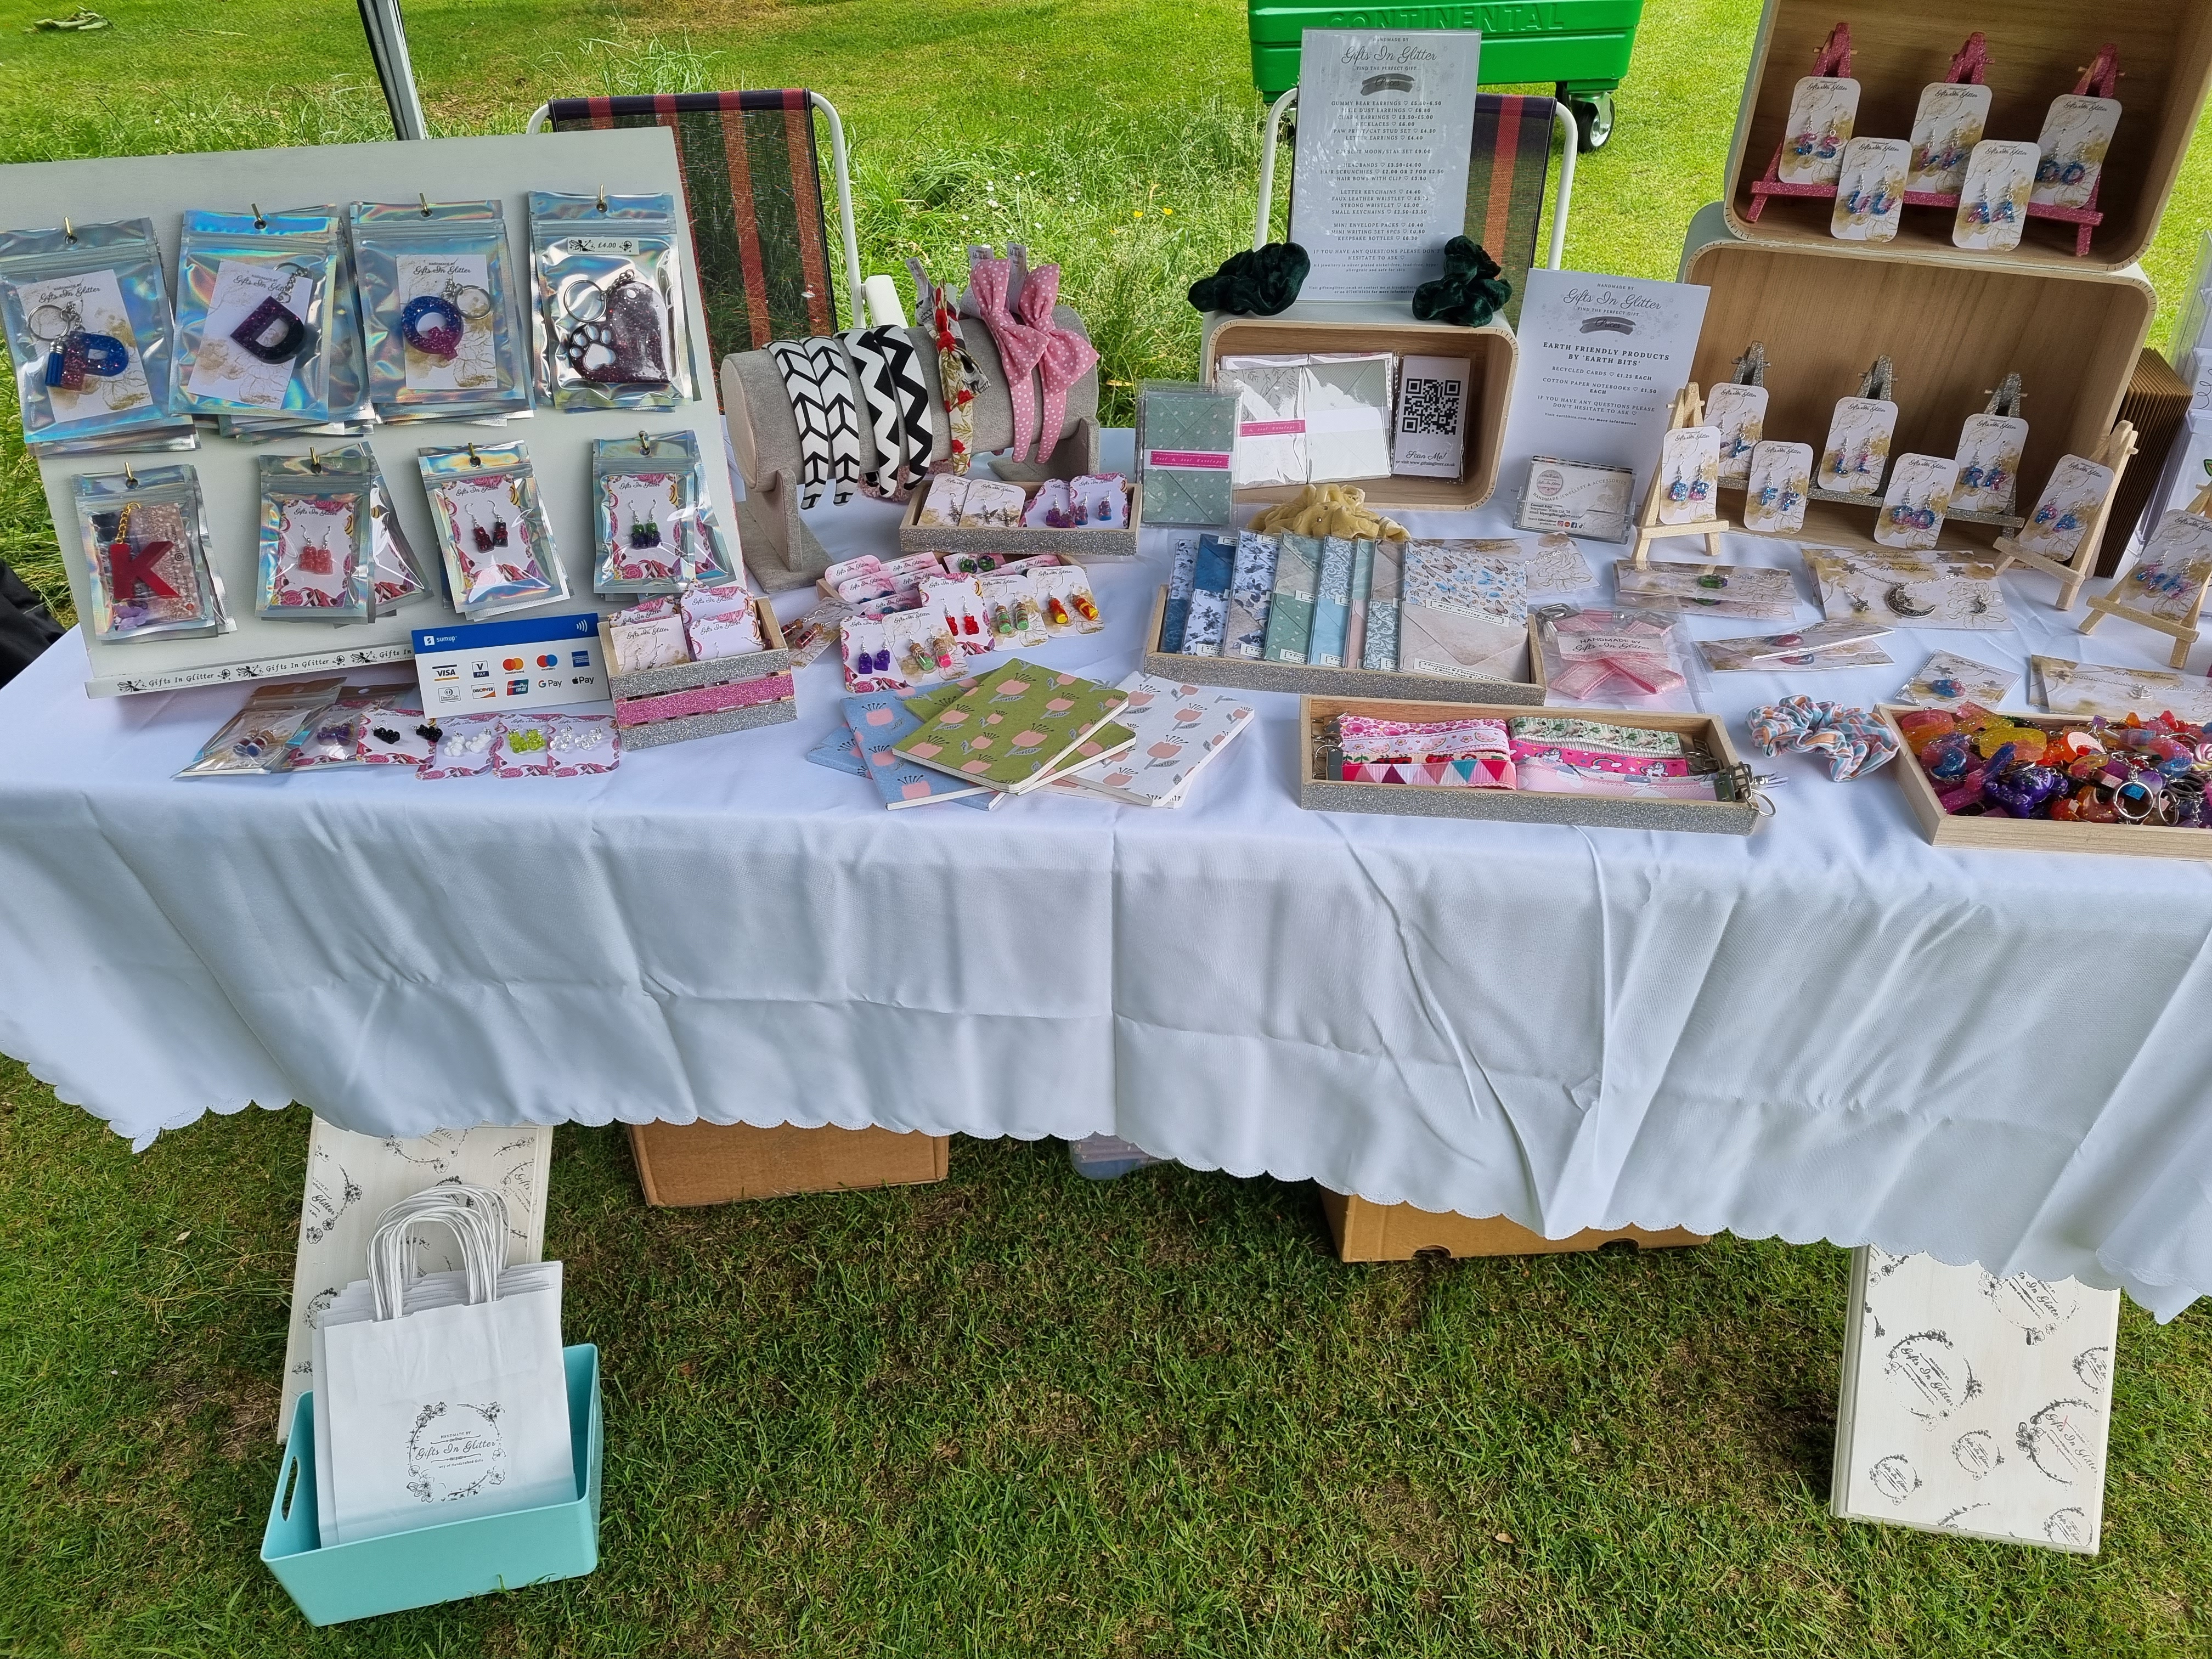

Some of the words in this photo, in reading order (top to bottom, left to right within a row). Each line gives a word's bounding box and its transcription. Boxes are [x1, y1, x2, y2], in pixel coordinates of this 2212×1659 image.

[1325, 3, 1564, 32] CONTINENTAL
[1341, 47, 1371, 64] Gifts
[1374, 46, 1396, 60] In
[1397, 46, 1437, 63] Glitter
[1375, 77, 1401, 87] Prices
[413, 266, 431, 275] Gifts
[448, 266, 471, 274] Glitter
[39, 293, 58, 303] Gifts
[76, 286, 100, 297] Glitter
[1564, 289, 1594, 304] Gifts
[1596, 291, 1618, 305] In
[1620, 294, 1661, 310] Glitter
[230, 295, 304, 365] D
[402, 296, 464, 361] Q
[1595, 319, 1621, 329] Prices
[1543, 342, 1572, 351] EARTH
[1575, 345, 1619, 356] FRIENDLY
[1622, 351, 1669, 360] PRODUCTS
[61, 331, 129, 391] P
[1592, 383, 1630, 391] NOTEBOOKS
[1594, 401, 1630, 409] QUESTIONS
[1427, 452, 1447, 461] Me!
[1533, 492, 1559, 501] HANDMADE
[1560, 484, 1587, 499] JEWELLERY
[109, 540, 180, 600] K
[380, 649, 400, 659] Gifts
[1572, 644, 1596, 652] Gifts
[266, 662, 287, 673] Gifts
[302, 658, 329, 668] Glitter
[149, 676, 171, 687] Gifts
[186, 673, 214, 682] Glitter
[548, 680, 562, 688] Pay
[579, 676, 594, 685] Pay
[1901, 1348, 1919, 1365] Gifts
[1920, 1367, 1931, 1380] In
[1930, 1383, 1953, 1406] Glitter
[415, 1447, 439, 1460] Gifts
[443, 1443, 460, 1453] In
[463, 1440, 495, 1453] Glitter
[2045, 1414, 2064, 1432] Gifts
[2064, 1434, 2075, 1446] In
[2075, 1449, 2097, 1473] Glitter
